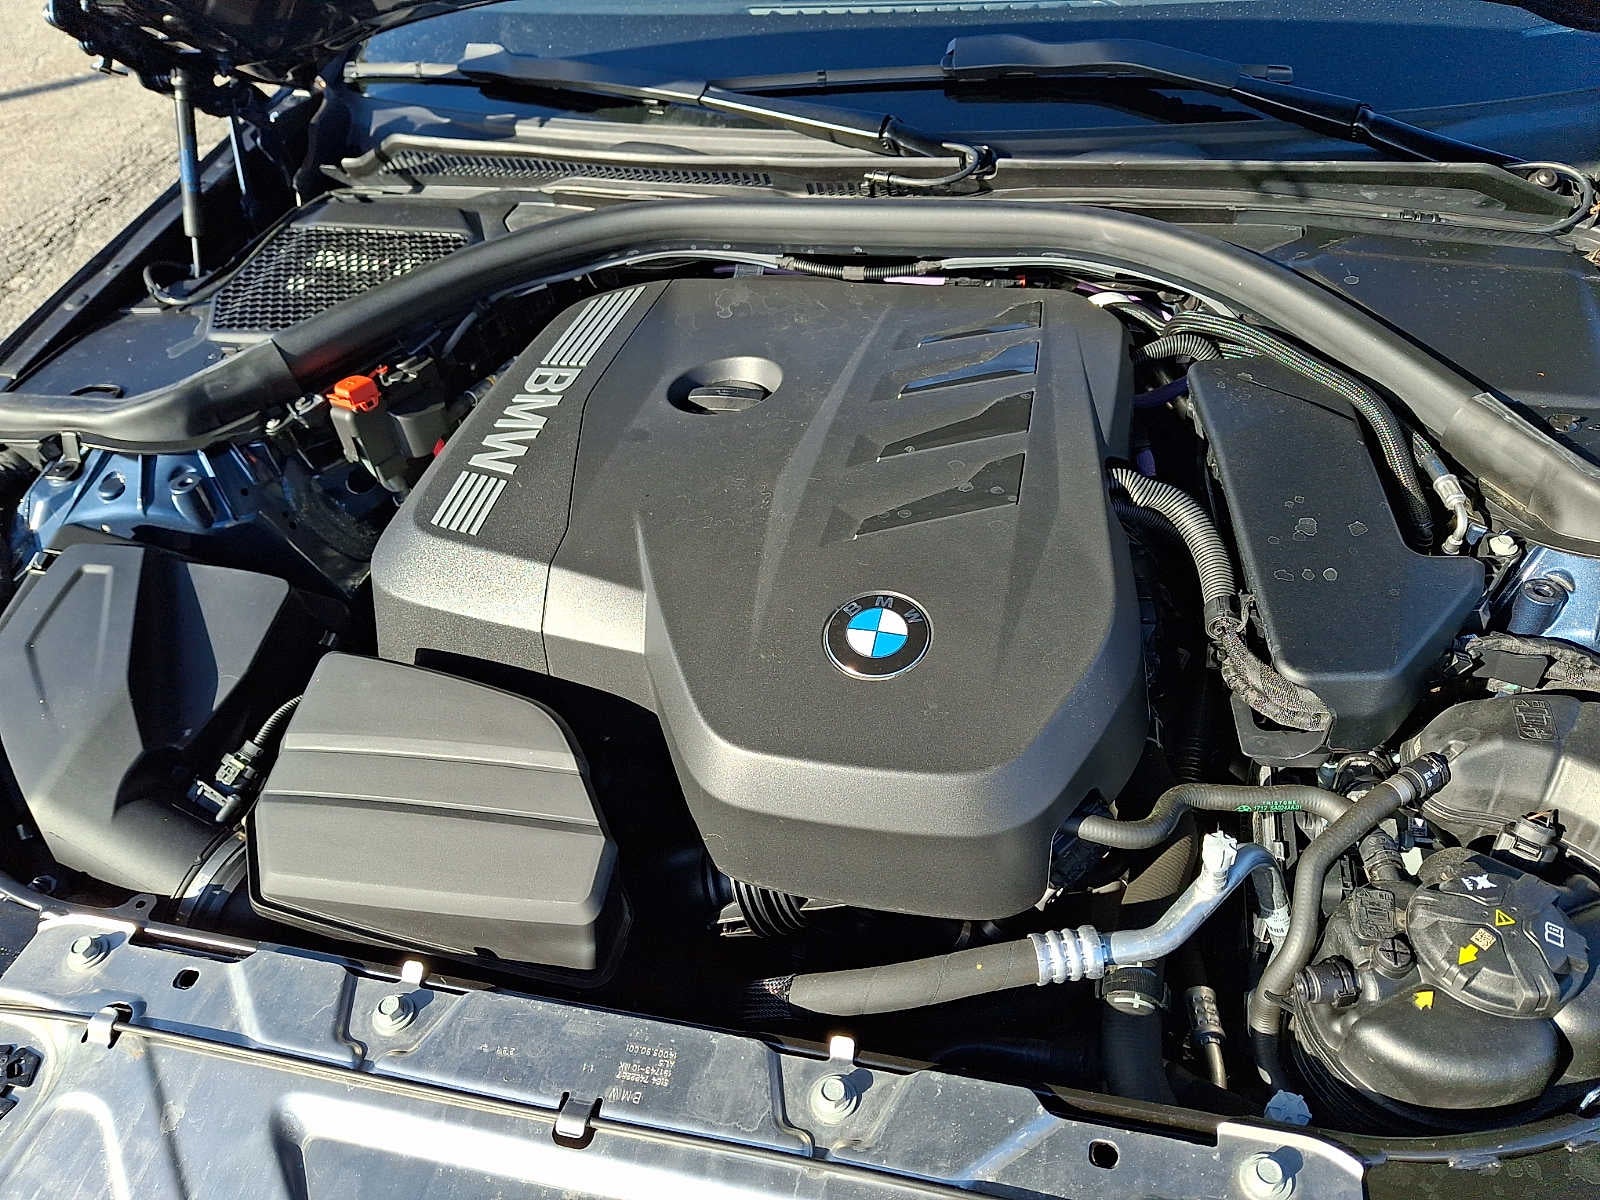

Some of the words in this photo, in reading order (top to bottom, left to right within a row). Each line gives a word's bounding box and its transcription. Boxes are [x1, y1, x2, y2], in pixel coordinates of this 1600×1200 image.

[469, 367, 583, 475] BMW
[842, 596, 923, 624] BMW
[608, 1087, 642, 1105] BMW
